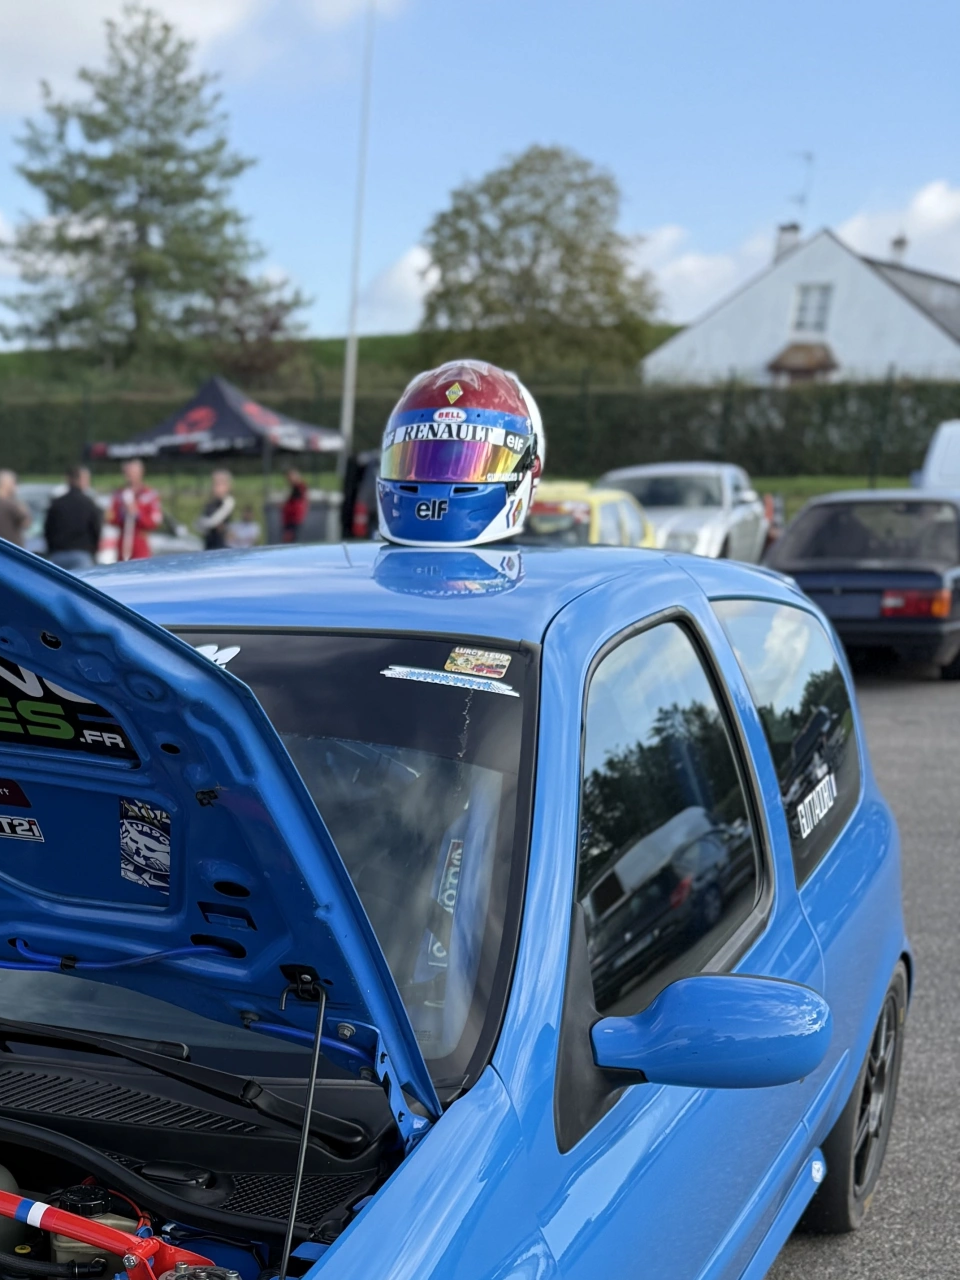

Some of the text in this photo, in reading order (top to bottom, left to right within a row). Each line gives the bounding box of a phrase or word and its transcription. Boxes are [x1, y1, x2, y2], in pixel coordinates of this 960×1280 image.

[437, 411, 462, 419] BELL
[402, 423, 494, 442] RENAULT
[506, 434, 524, 451] elf
[415, 498, 449, 521] elf
